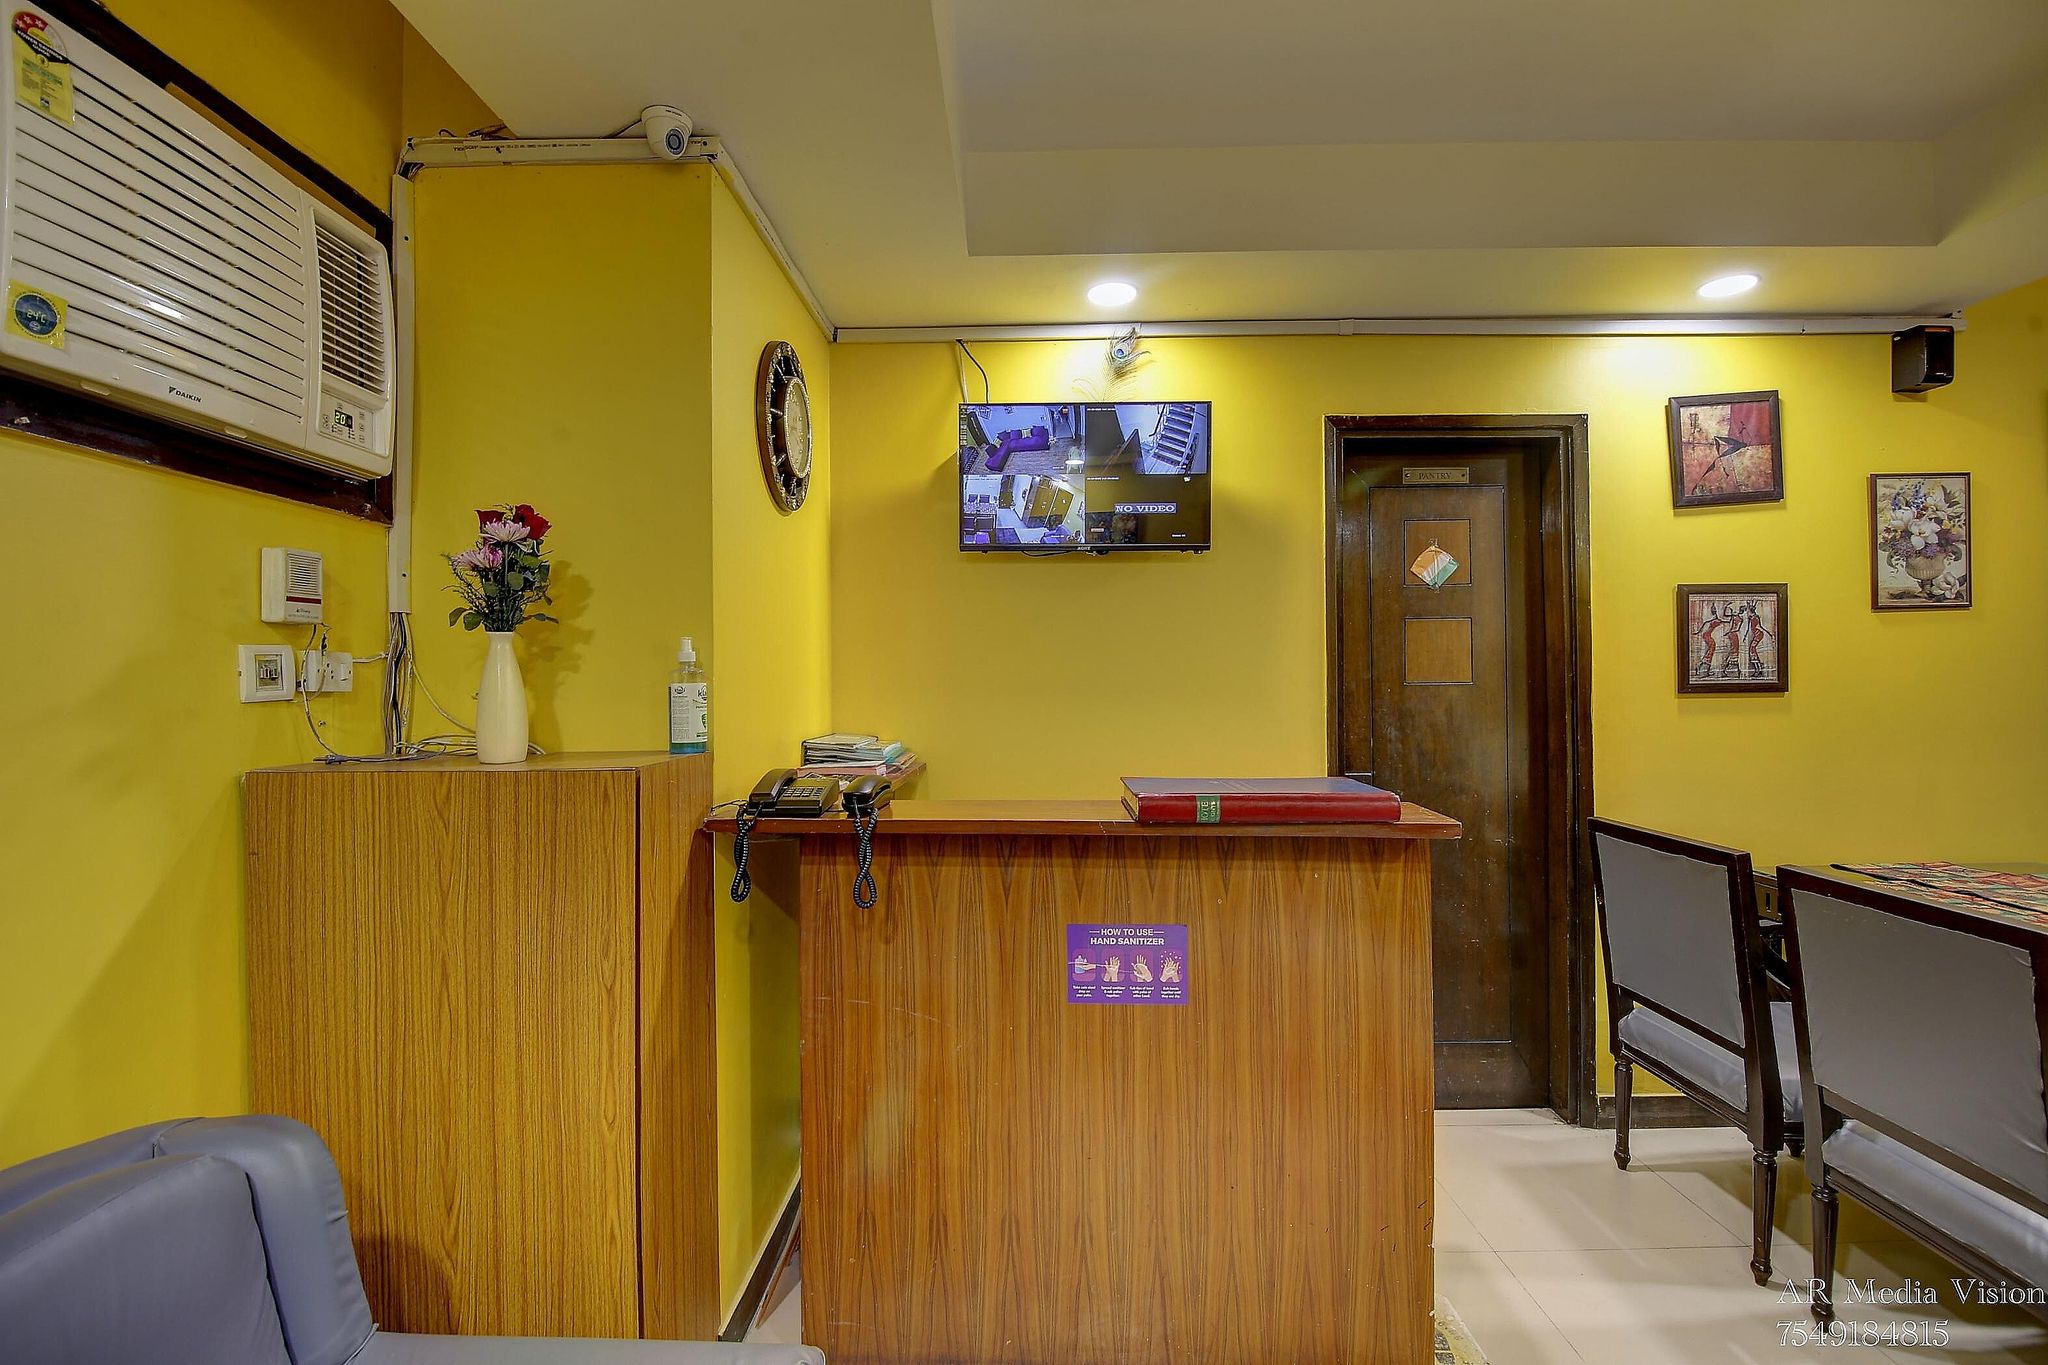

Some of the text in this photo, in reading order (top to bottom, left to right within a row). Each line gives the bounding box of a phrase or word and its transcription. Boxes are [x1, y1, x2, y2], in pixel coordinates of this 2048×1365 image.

[175, 390, 202, 403] DAIKIN
[335, 411, 346, 425] 20
[1418, 472, 1452, 480] PANTRY
[1100, 928, 1154, 936] HOW TO USE
[1090, 937, 1165, 945] HAND SANITIZER
